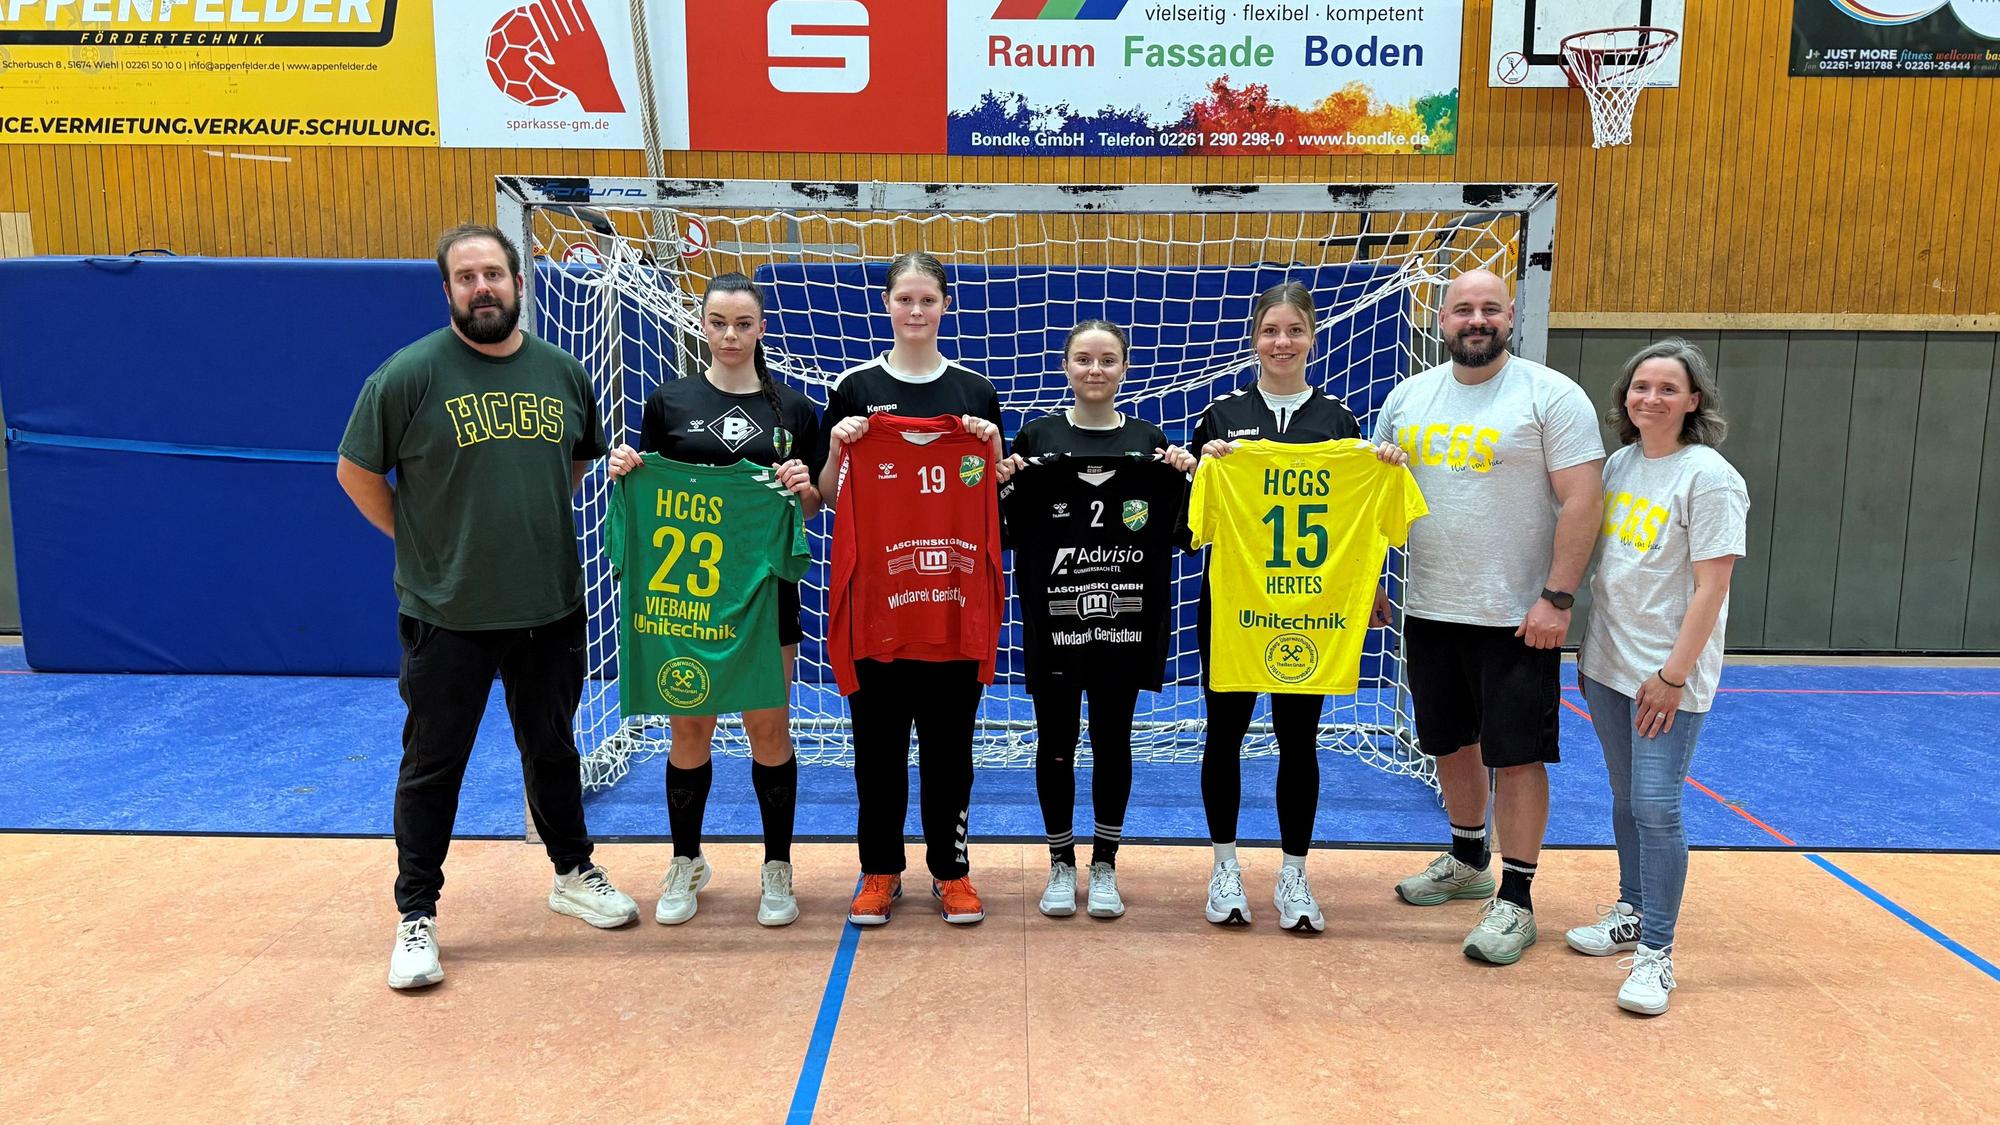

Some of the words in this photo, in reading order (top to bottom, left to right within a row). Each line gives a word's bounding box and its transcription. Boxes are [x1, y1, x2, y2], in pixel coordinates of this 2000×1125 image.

[0, 0, 372, 22] PPENFELDER
[1145, 4, 1226, 24] vielseitig
[1243, 4, 1309, 21] flexibel
[1326, 4, 1425, 24] kompetent
[80, 31, 264, 44] FÖRDERTECHNIK
[988, 35, 1095, 67] Raum
[1124, 35, 1274, 67] Fassade
[1304, 35, 1424, 67] Boden
[1824, 49, 1857, 60] JUST
[1860, 49, 1897, 60] MORE
[1900, 48, 1933, 62] fitness
[1935, 48, 1983, 60] wellcome
[2, 60, 54, 69] Scherbusch
[67, 61, 92, 69] 51674
[93, 61, 119, 69] Wiehl
[125, 61, 150, 69] 02261
[152, 61, 163, 69] 50
[164, 61, 173, 69] 10
[175, 61, 182, 69] 0
[189, 61, 280, 72] info@appenfelder.de
[287, 62, 378, 72] www.appenfelder.de
[1904, 61, 1971, 70] 02261-26444
[506, 117, 610, 133] sparkasse-gm.de
[971, 131, 1031, 147] Bondke
[1034, 131, 1085, 147] GmbH
[1098, 131, 1155, 147] Telefon
[1159, 131, 1204, 147] 02261
[1209, 131, 1238, 147] 290
[1242, 131, 1285, 147] 298-0
[1298, 131, 1430, 147] www.bondke.de
[866, 403, 898, 413] Kempa
[445, 391, 564, 448] HCGS
[1227, 426, 1260, 438] hummel
[1397, 422, 1502, 473] HCGS
[916, 464, 946, 494] 19
[1263, 468, 1331, 497] HCGS
[656, 488, 724, 525] HCGS
[1090, 500, 1104, 528] 2
[885, 538, 949, 553] LASCHINSKI
[949, 538, 978, 552] GMBH
[1261, 503, 1329, 569] 15
[648, 526, 724, 598] 23
[1076, 545, 1144, 565] Advisio
[1110, 565, 1121, 573] ETL
[1047, 582, 1109, 593] LASCHINSKI
[1111, 583, 1144, 591] GMBH
[1265, 575, 1323, 595] HERTES
[645, 596, 711, 622] VIEBAHN
[634, 612, 737, 641] Unitechnik
[1239, 609, 1347, 630] Unitechnik
[1094, 626, 1142, 643] Gerüstbau
